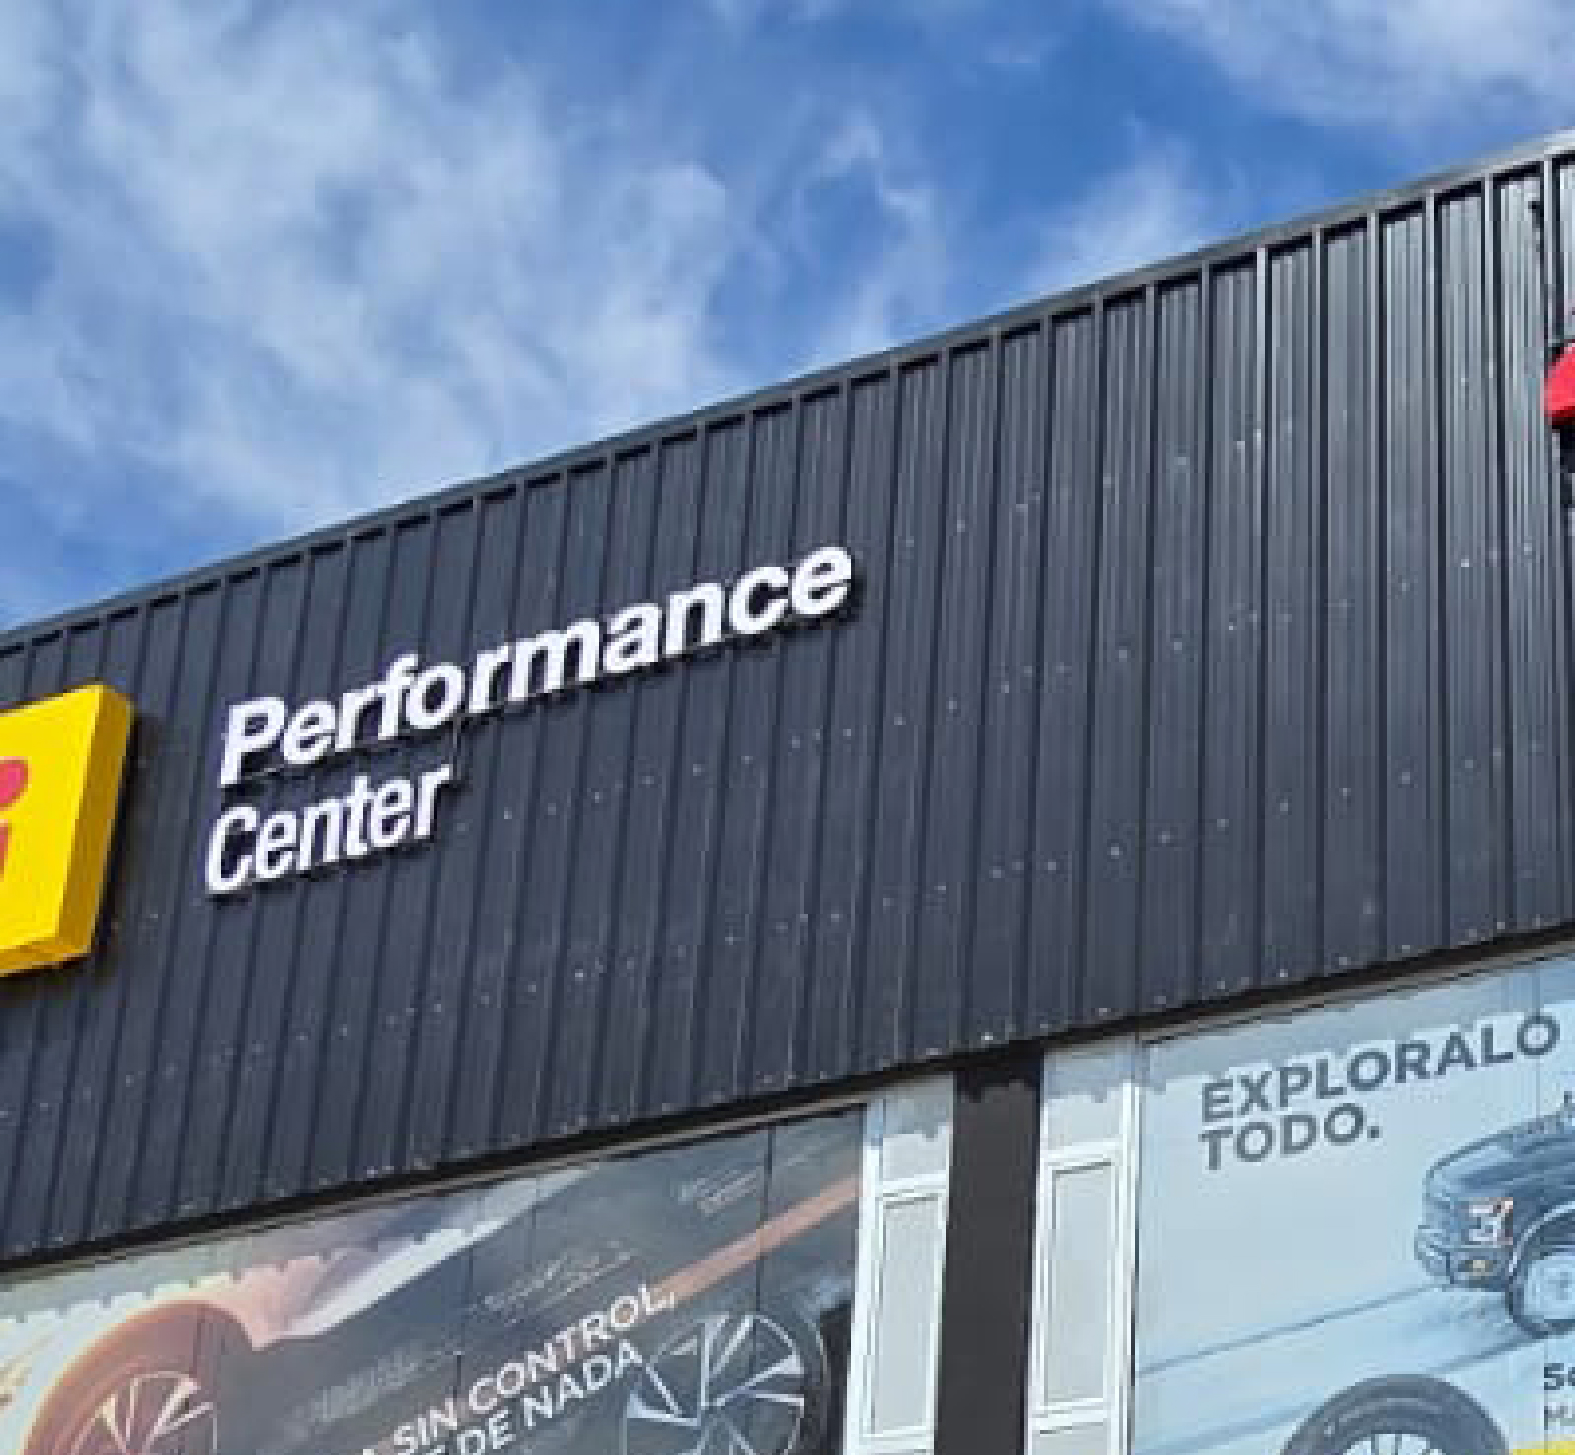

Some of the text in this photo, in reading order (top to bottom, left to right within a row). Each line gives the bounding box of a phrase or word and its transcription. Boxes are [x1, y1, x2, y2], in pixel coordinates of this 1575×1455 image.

[220, 545, 852, 787] Performance
[205, 764, 453, 895] Center
[1202, 1014, 1561, 1123] EXPLORALO
[1198, 1102, 1383, 1171] TODO.
[468, 1284, 678, 1414] CONTROL,
[522, 1338, 647, 1430] NADA
